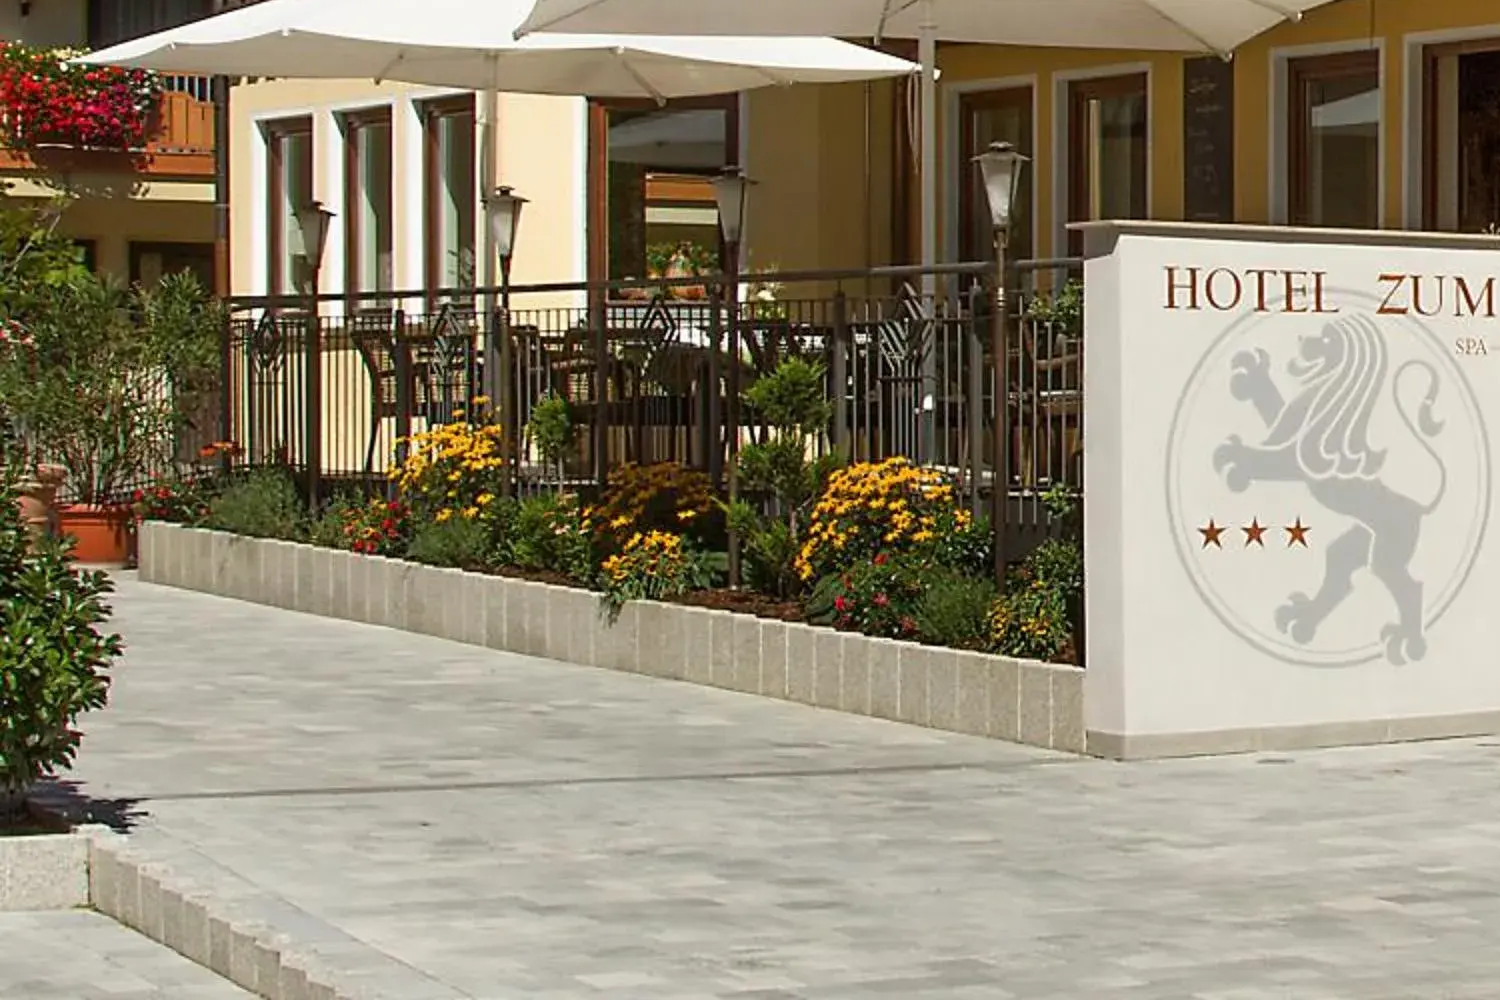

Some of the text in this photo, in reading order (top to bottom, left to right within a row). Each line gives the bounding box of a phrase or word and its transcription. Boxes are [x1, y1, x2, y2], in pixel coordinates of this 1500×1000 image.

[1162, 265, 1340, 313] HOTEL
[1375, 273, 1497, 317] ZUM
[1455, 337, 1488, 356] SPA
